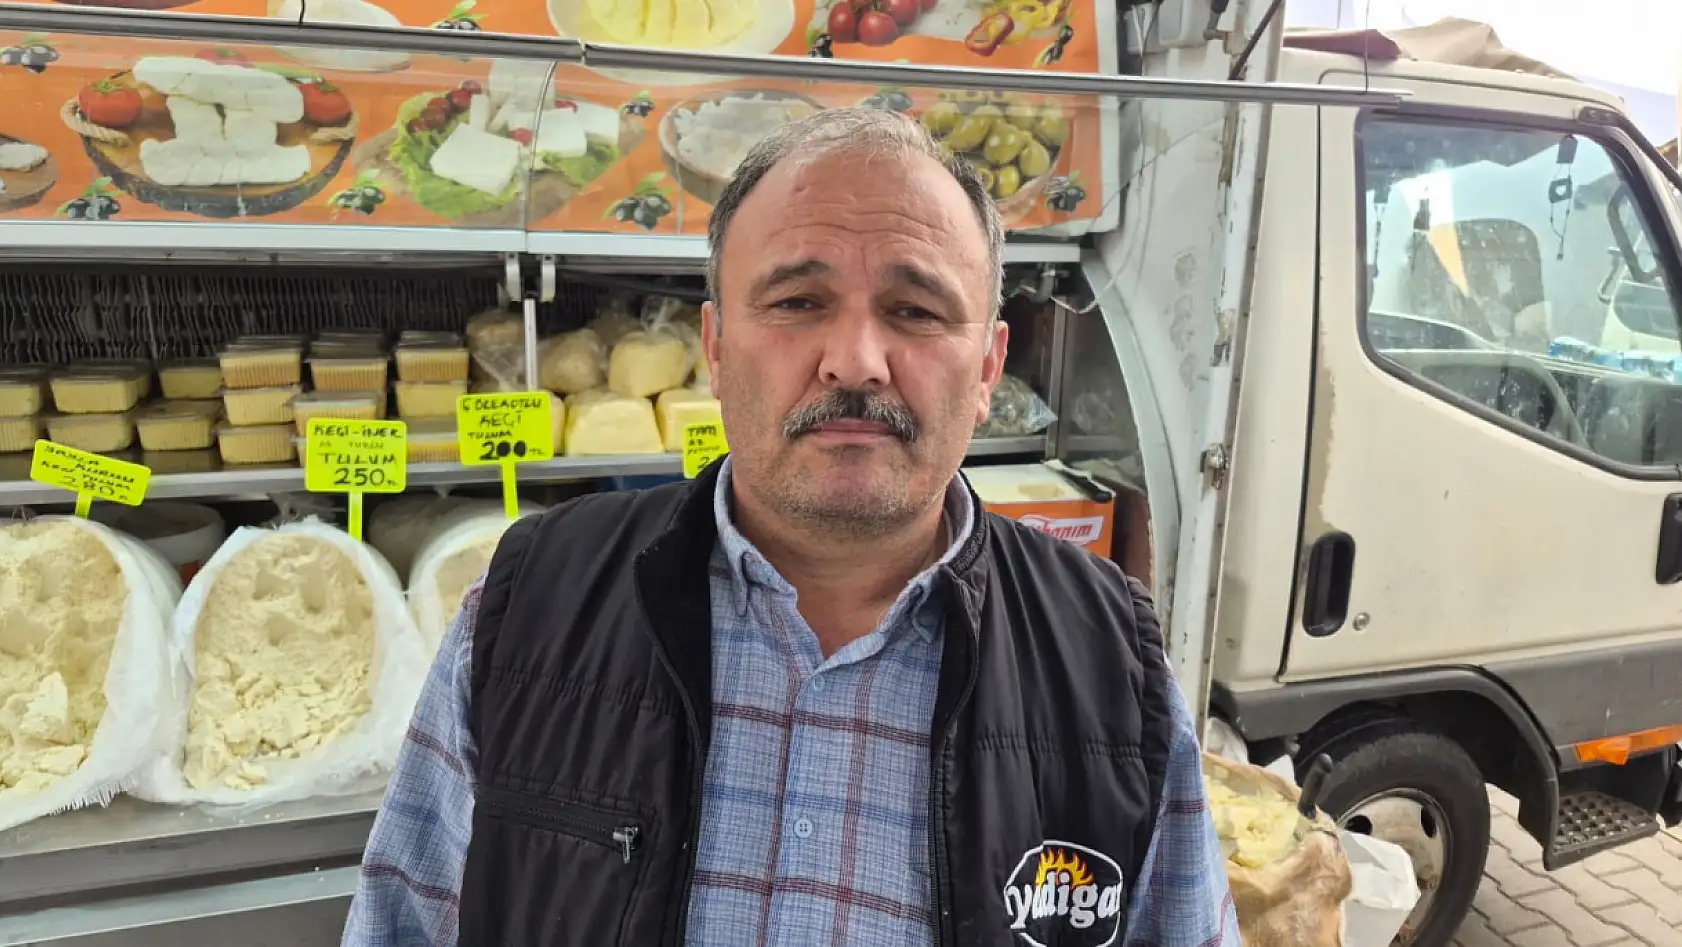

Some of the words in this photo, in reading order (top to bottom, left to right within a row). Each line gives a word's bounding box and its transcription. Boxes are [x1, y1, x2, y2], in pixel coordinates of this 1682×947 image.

[317, 452, 398, 466] TULUM
[479, 440, 526, 460] 200
[334, 468, 385, 487] 250
